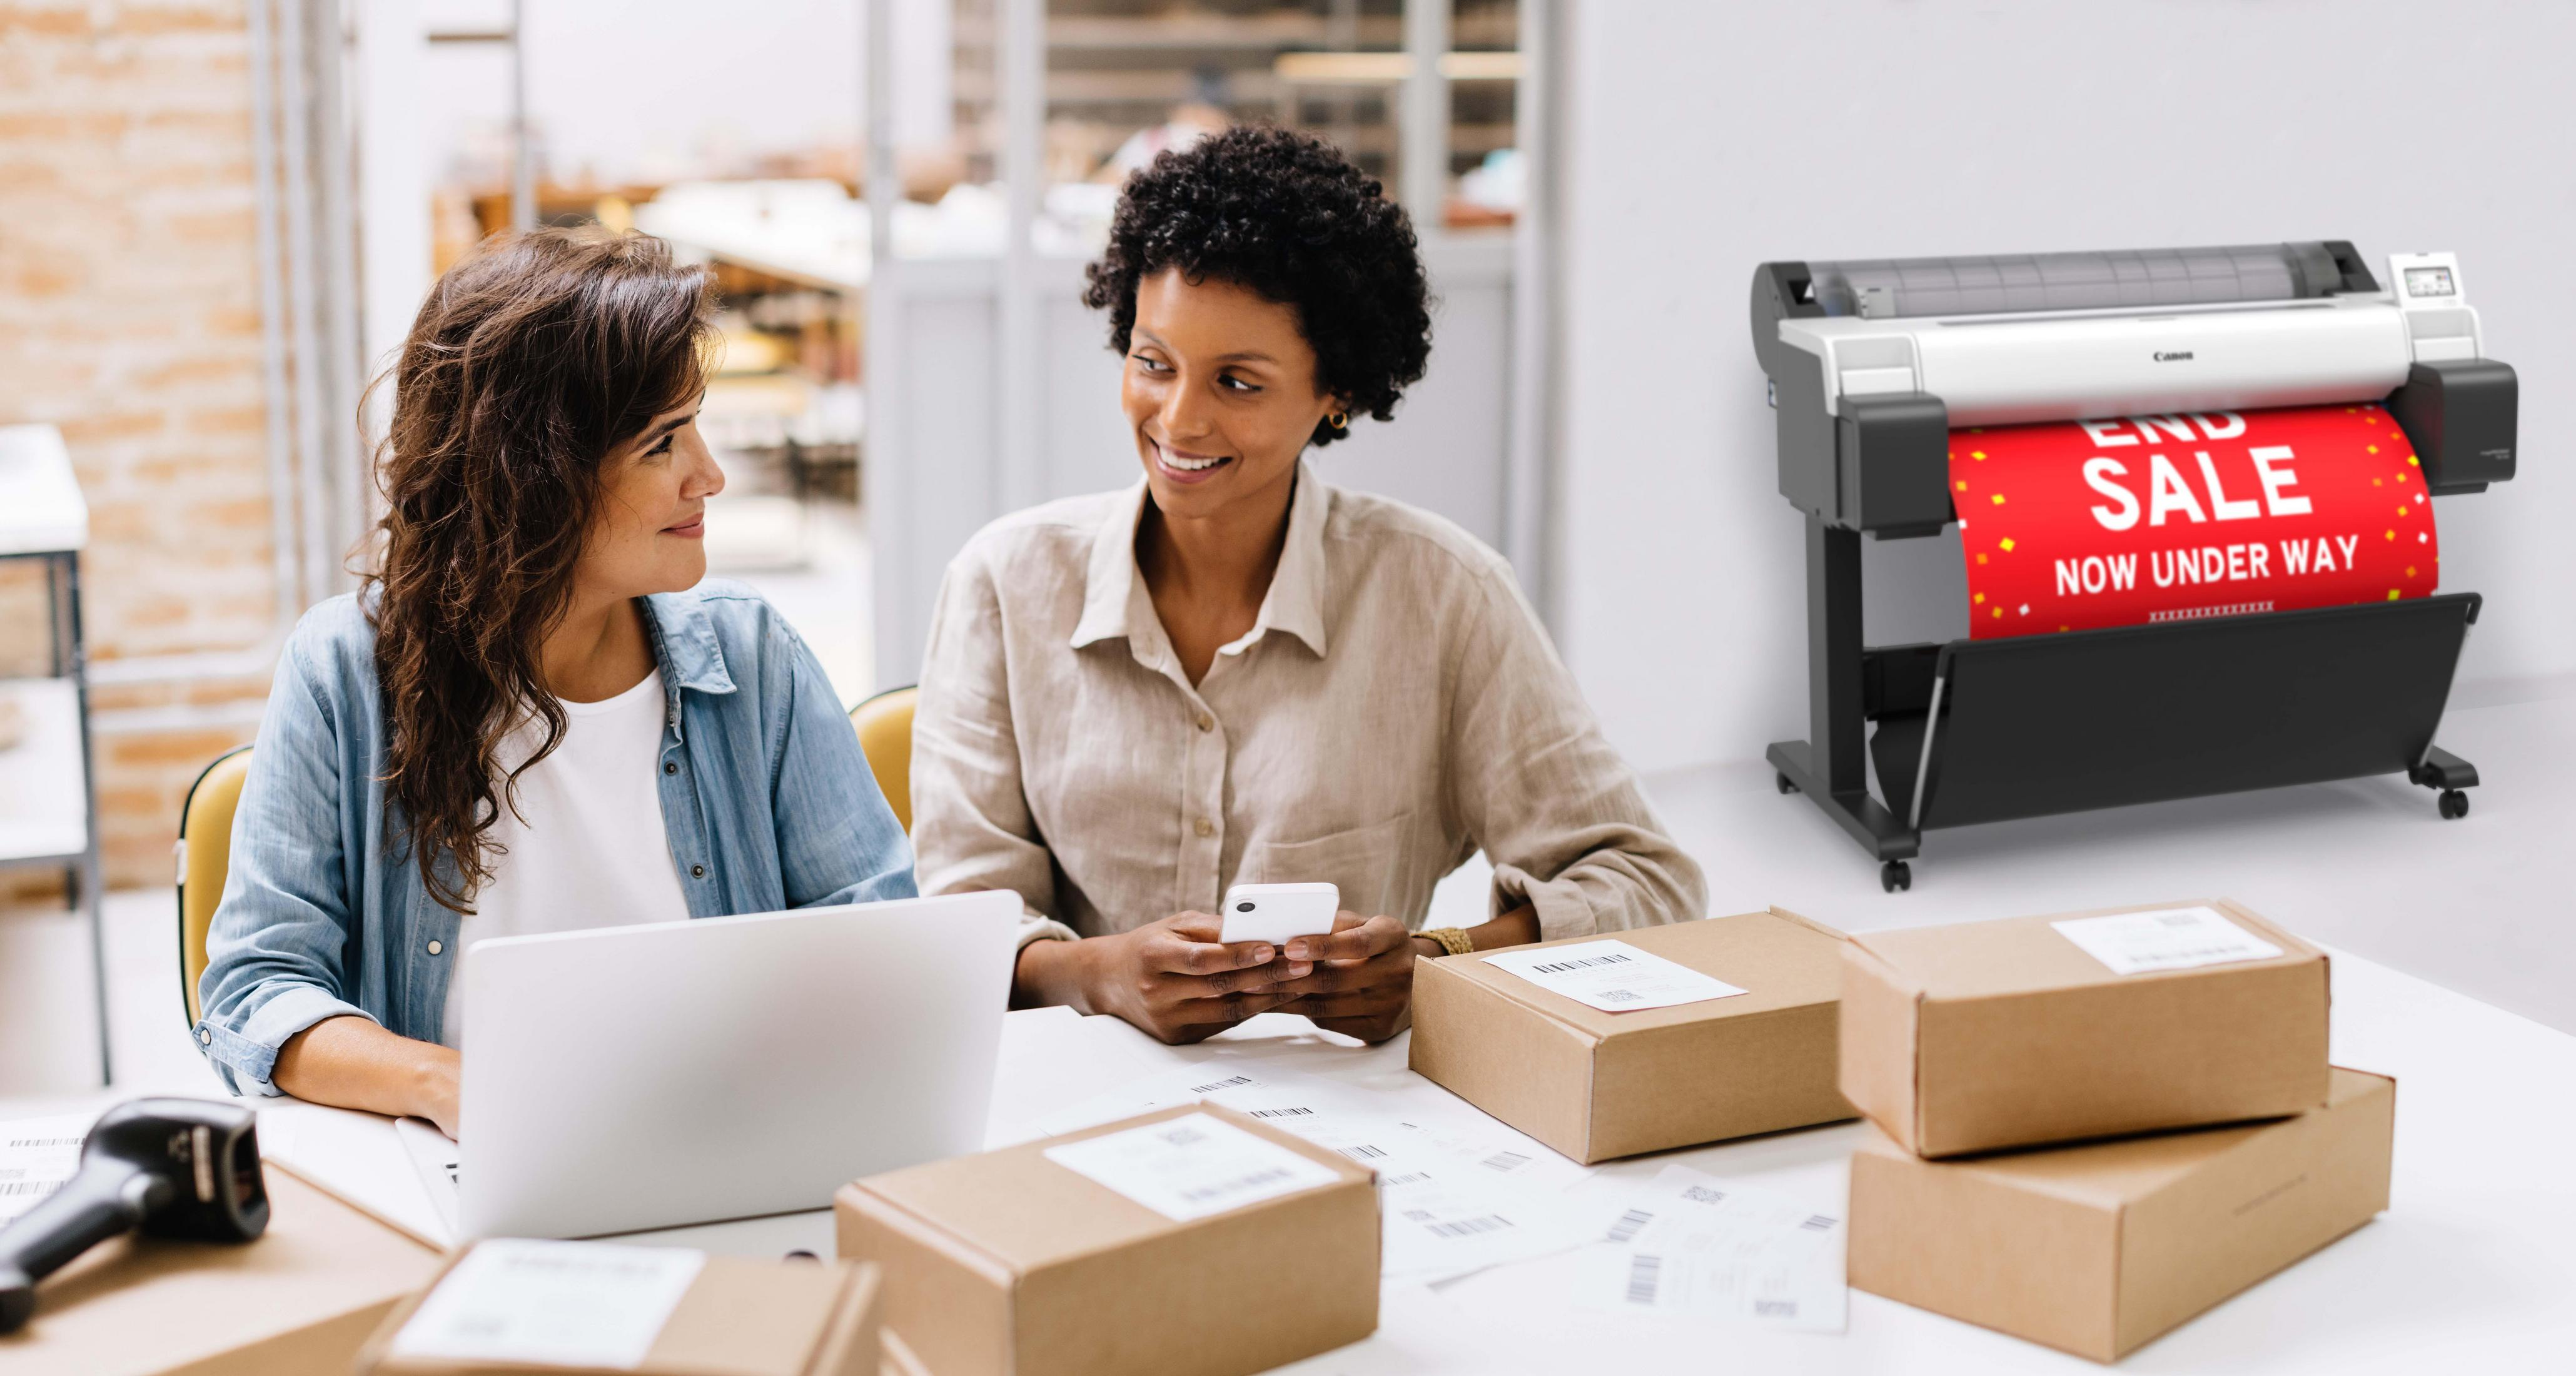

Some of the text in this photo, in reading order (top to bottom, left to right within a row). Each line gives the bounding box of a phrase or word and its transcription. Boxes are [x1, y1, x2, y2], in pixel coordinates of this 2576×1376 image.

[2153, 351, 2194, 362] Canon
[2076, 412, 2247, 447] END
[2083, 445, 2313, 531] SALE
[2054, 534, 2359, 596] NOW UNDER WAY
